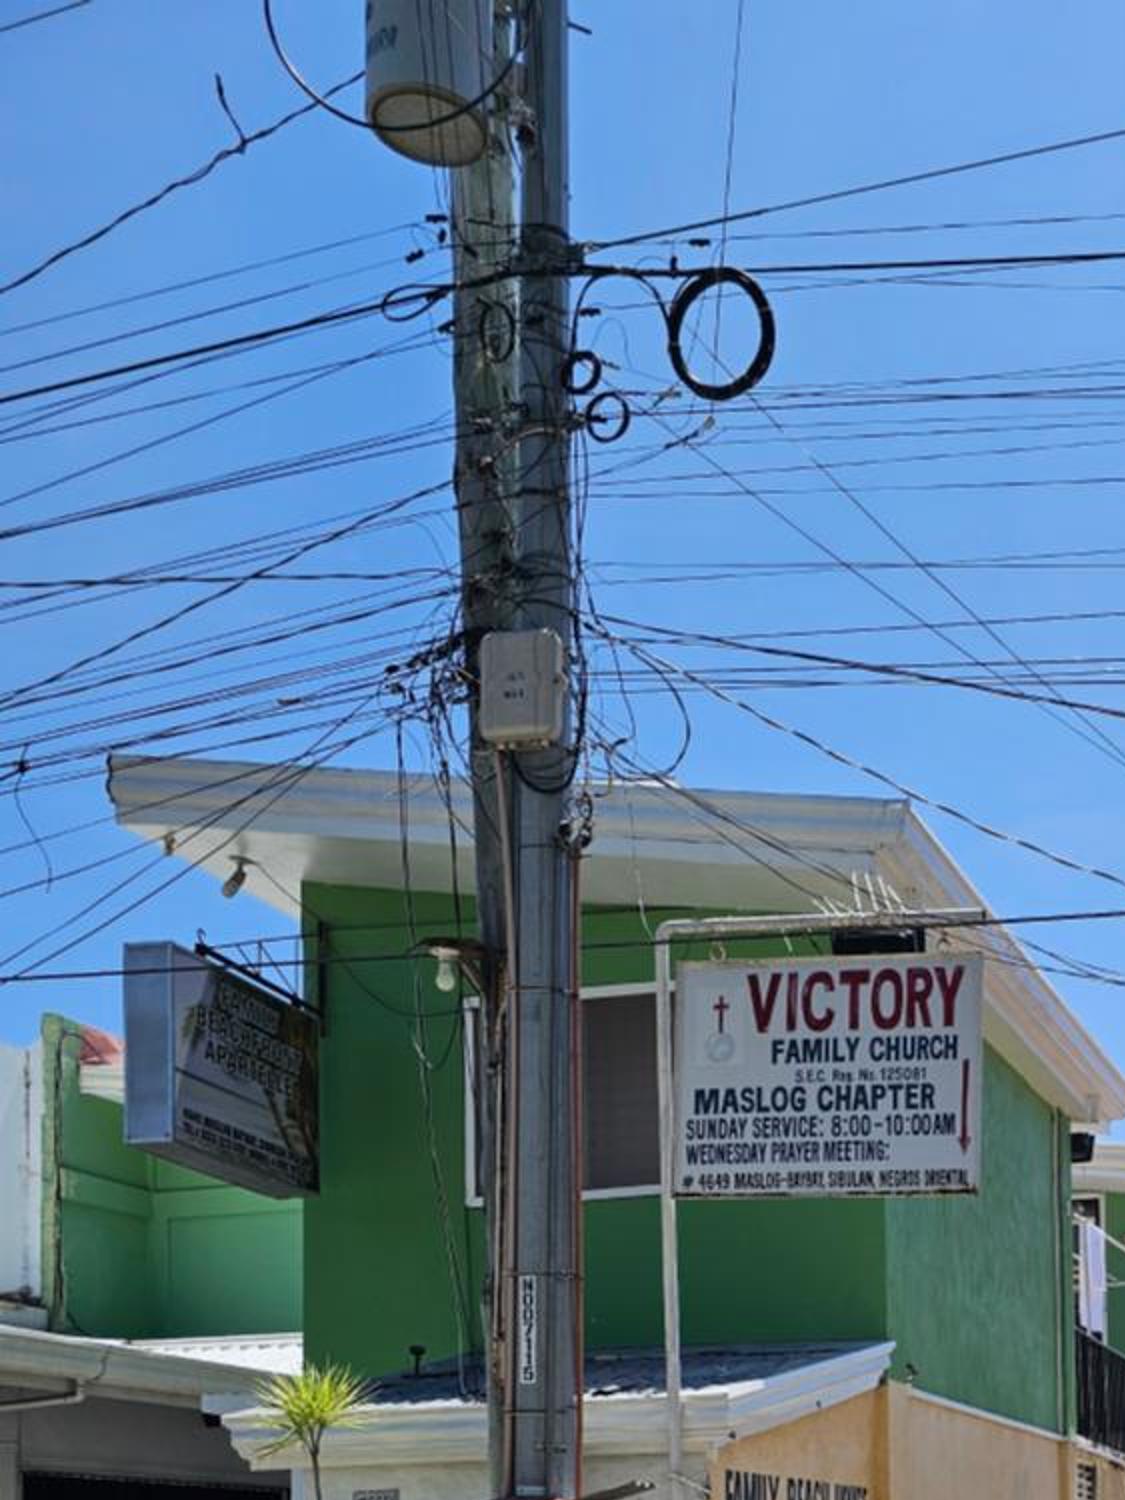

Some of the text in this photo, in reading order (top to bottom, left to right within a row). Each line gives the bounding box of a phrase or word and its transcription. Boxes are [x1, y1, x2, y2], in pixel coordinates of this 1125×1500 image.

[747, 965, 965, 1034] VICTORY
[771, 1034, 959, 1065] FAMILY CHURCH
[693, 1082, 936, 1115] MASLOG CHAPTER
[686, 1118, 748, 1141] SUNDAY
[752, 1115, 824, 1138] SERVICE:
[686, 1139, 890, 1165] WEDNESDAY PRAYER MEETING:
[878, 1168, 921, 1187] NEGROS
